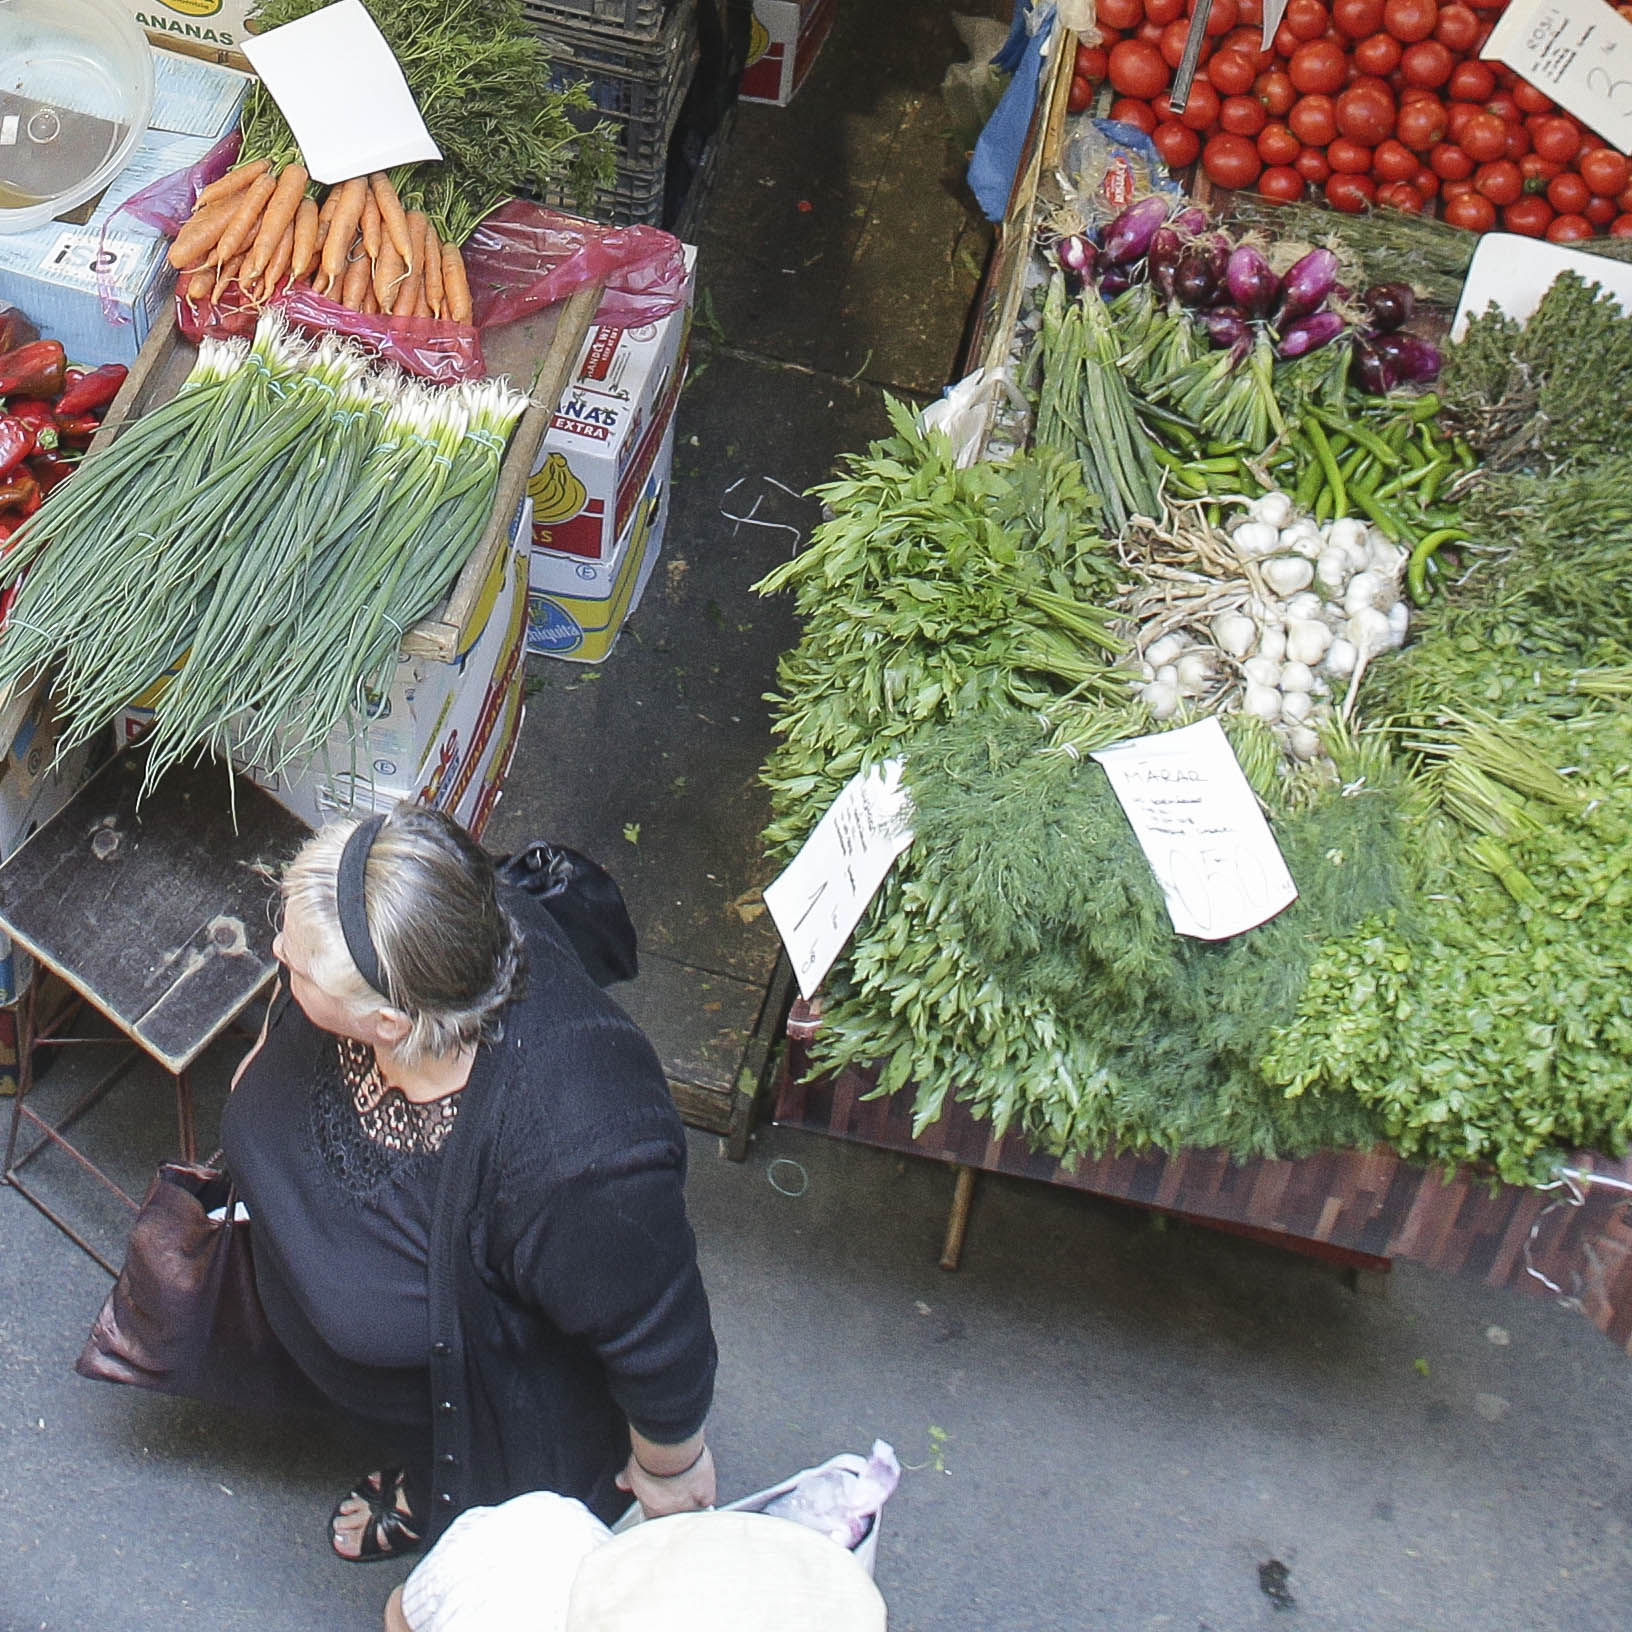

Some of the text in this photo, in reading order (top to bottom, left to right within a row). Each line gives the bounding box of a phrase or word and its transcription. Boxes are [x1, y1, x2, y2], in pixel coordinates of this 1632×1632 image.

[135, 11, 234, 46] ANANAS
[555, 418, 605, 440] EXTRA
[528, 624, 581, 644] hiquita
